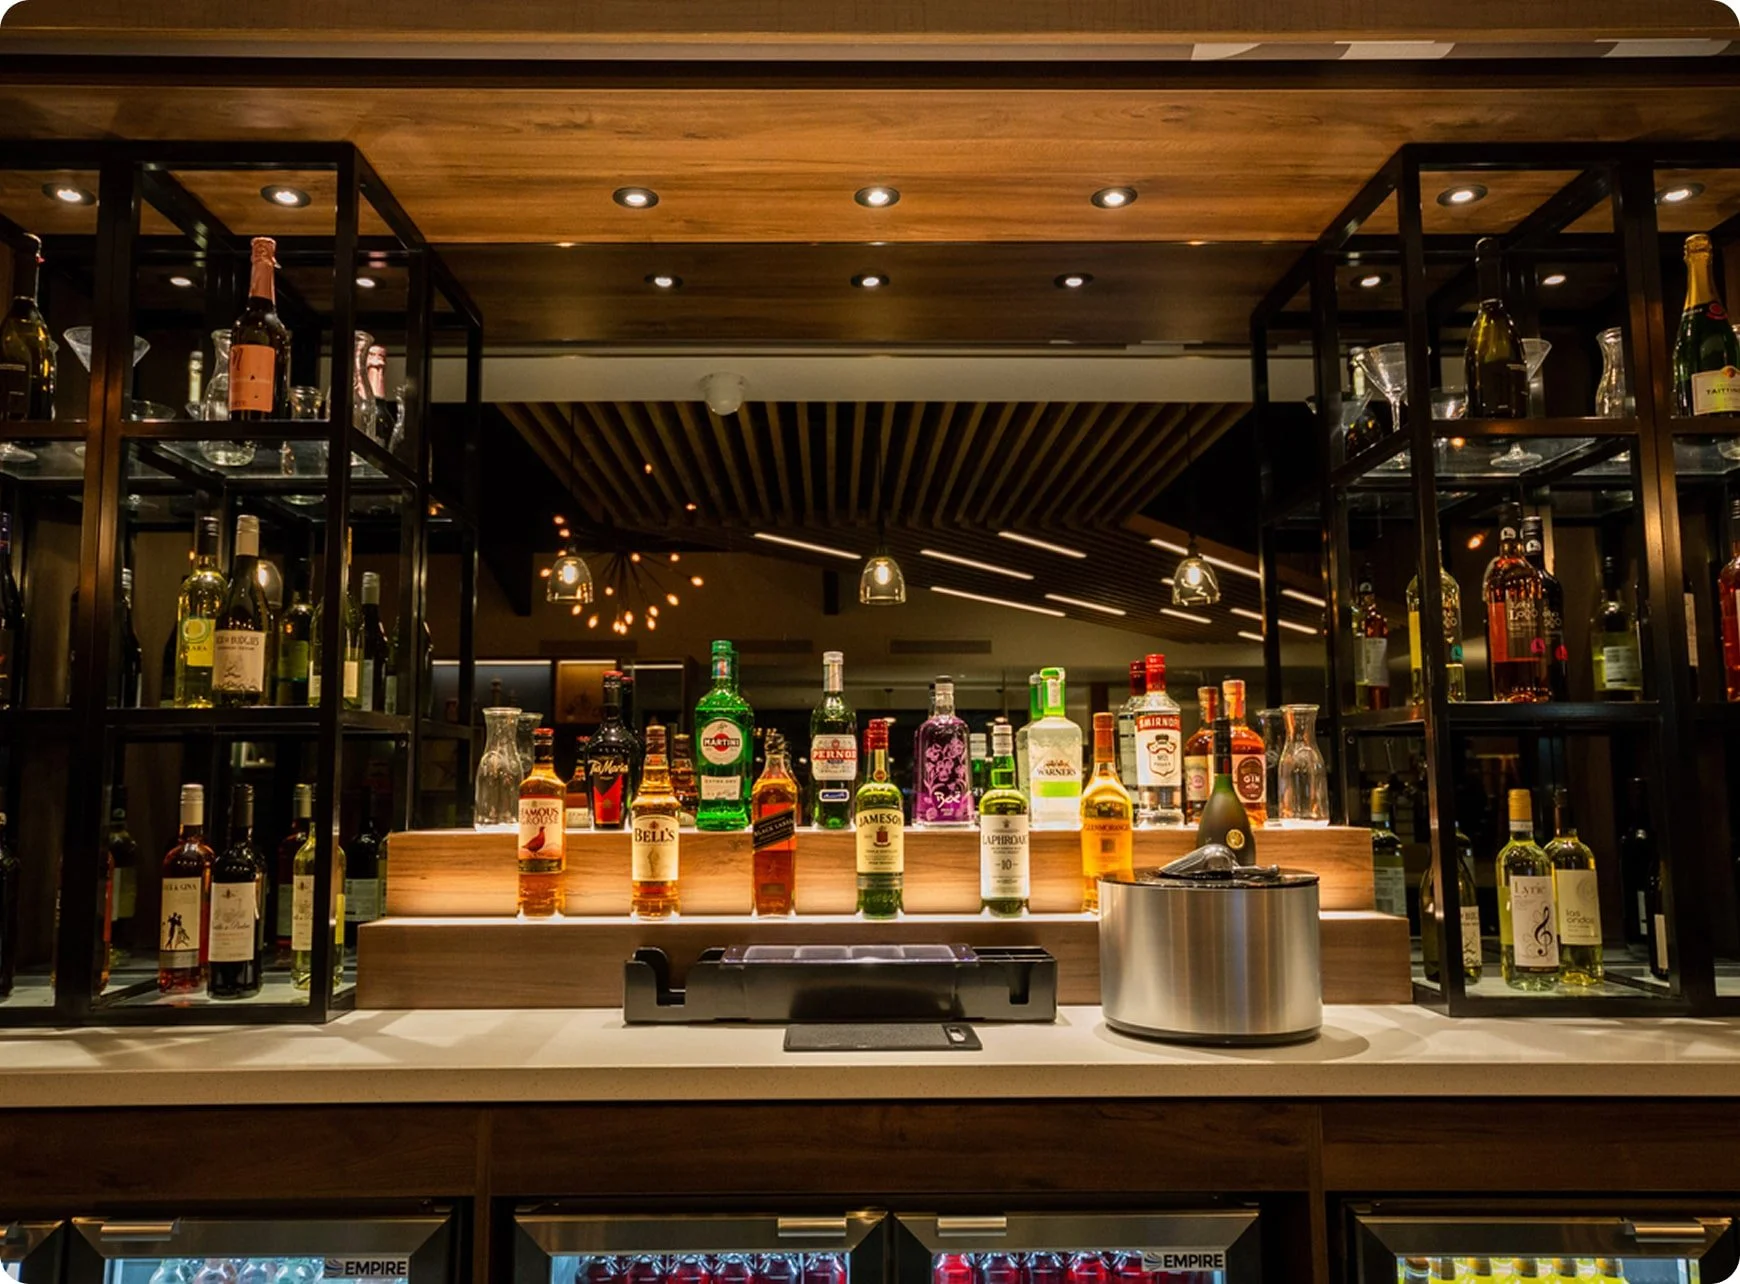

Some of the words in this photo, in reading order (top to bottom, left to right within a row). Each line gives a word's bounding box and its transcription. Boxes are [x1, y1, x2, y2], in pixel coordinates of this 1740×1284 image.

[704, 738, 740, 747] MARTINI
[588, 760, 601, 776] Tia
[600, 760, 628, 774] Maria
[1243, 775, 1260, 784] GIN
[521, 807, 559, 816] FAMOUS
[634, 827, 675, 843] BELL'S
[1001, 859, 1012, 871] 10
[1514, 882, 1547, 895] Lyric
[1164, 1254, 1224, 1268] EMPIRE
[345, 1261, 407, 1275] EMPIRE
